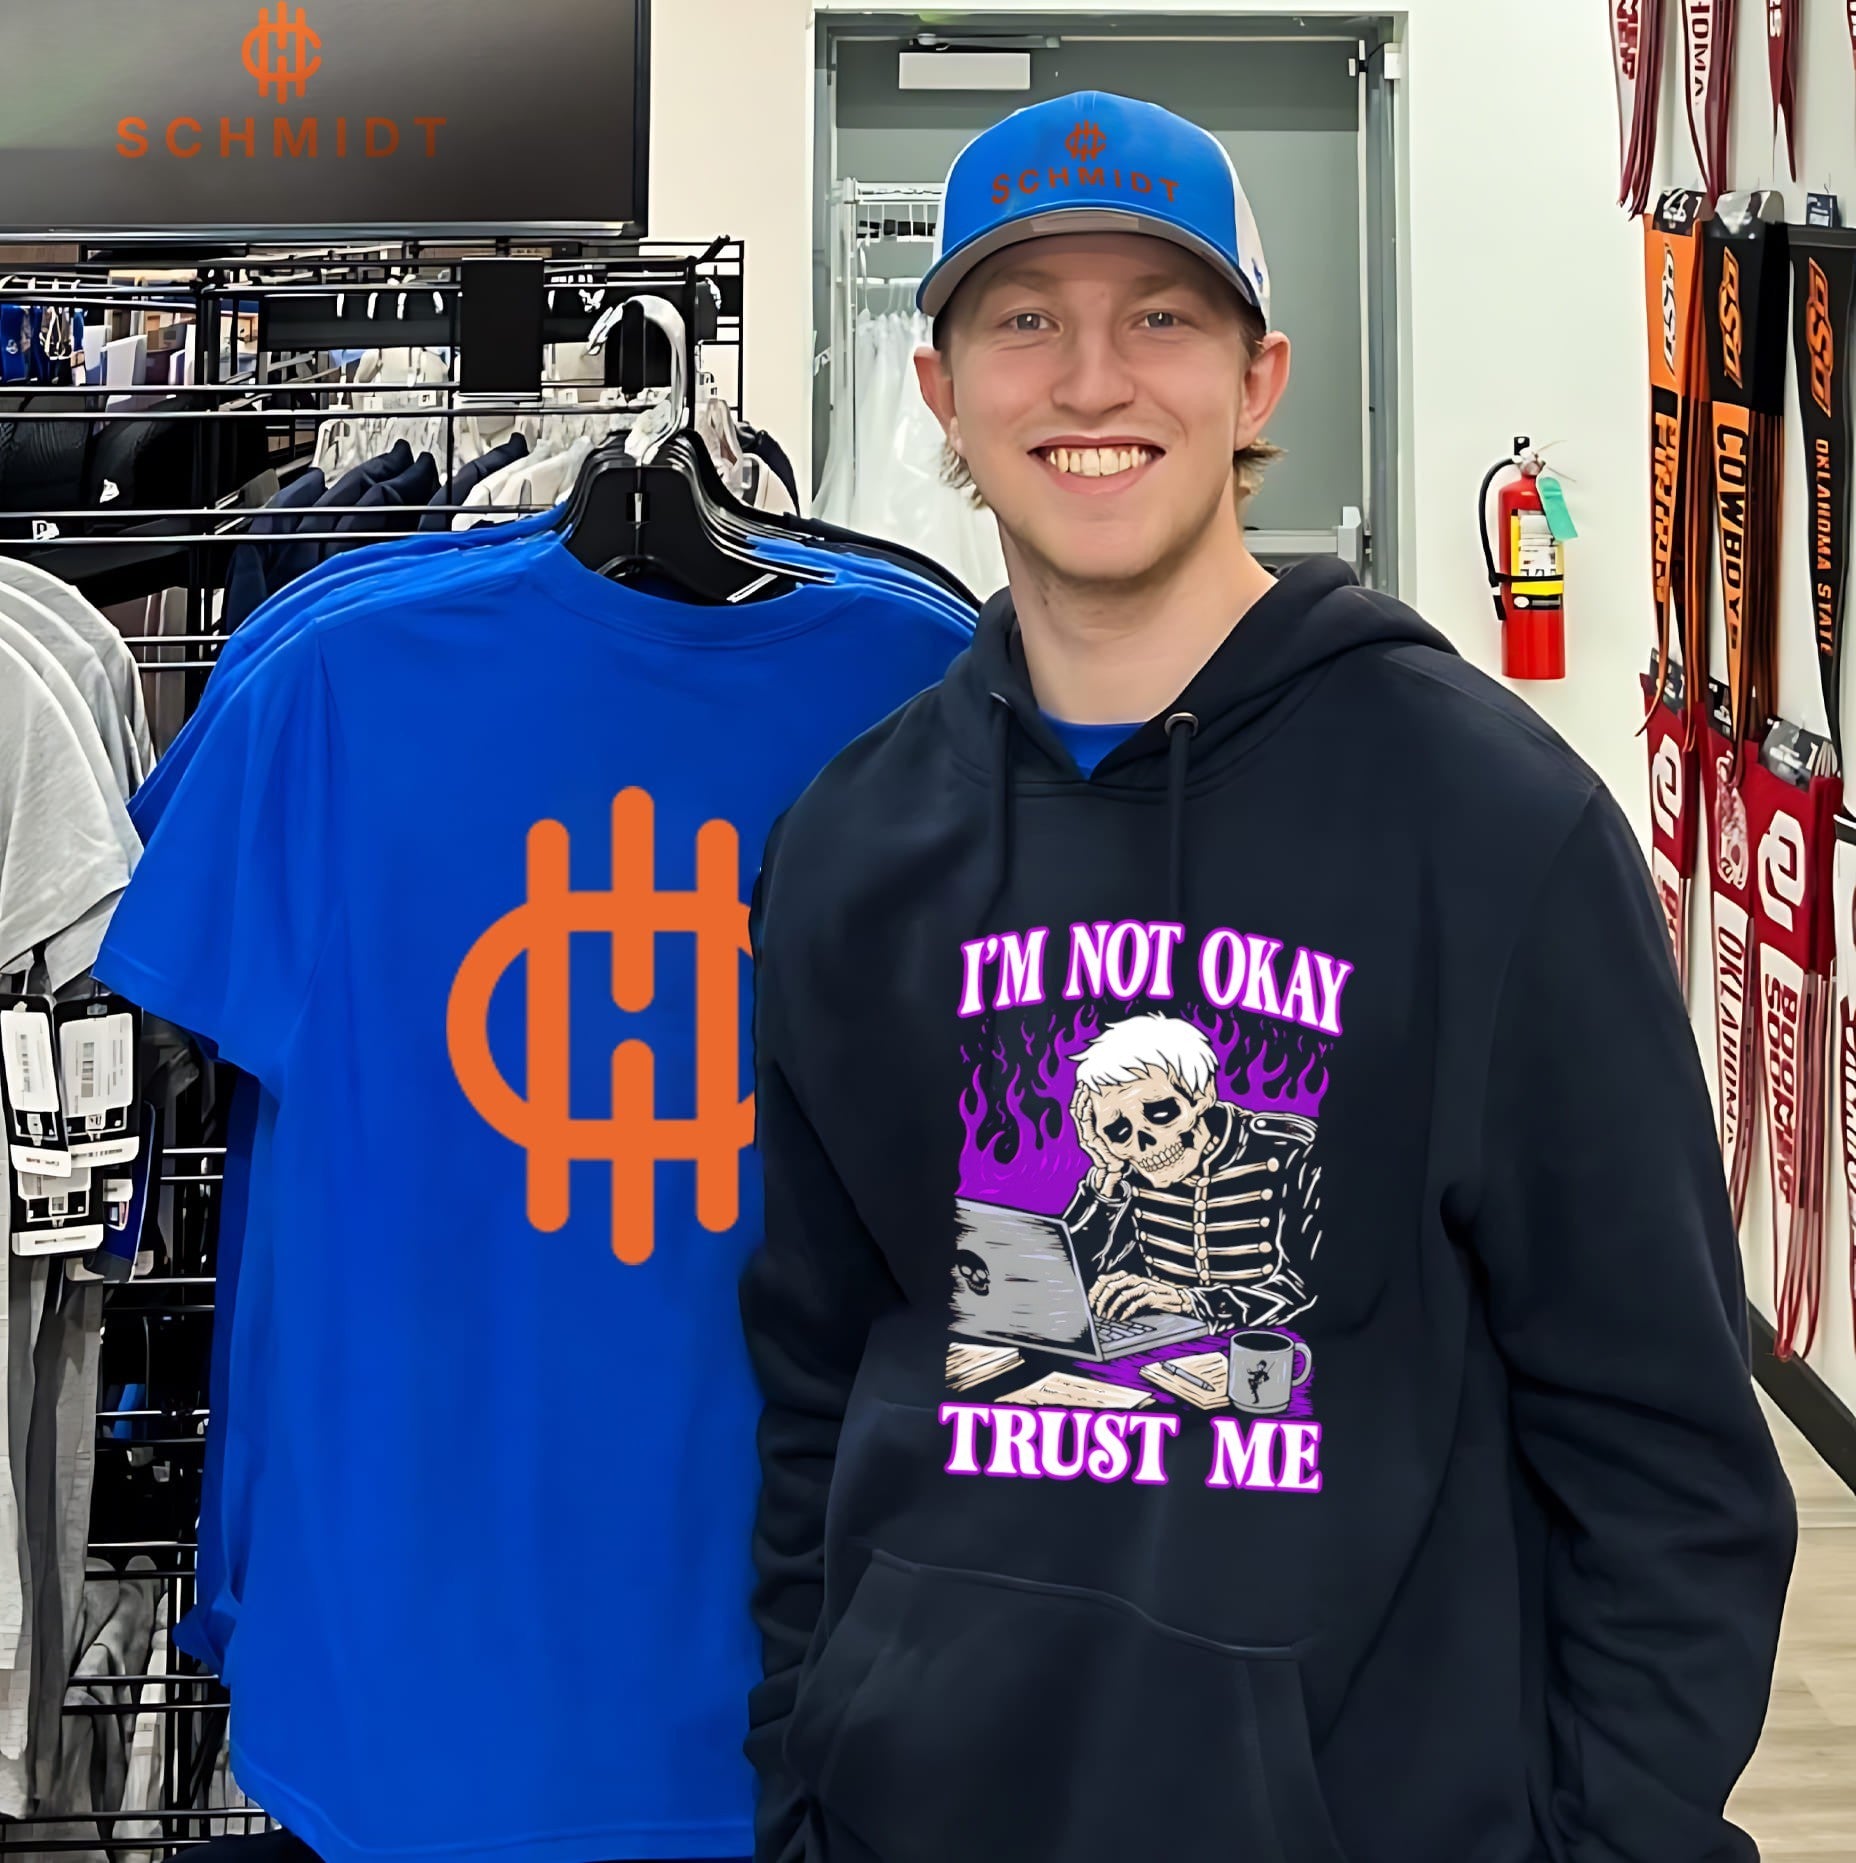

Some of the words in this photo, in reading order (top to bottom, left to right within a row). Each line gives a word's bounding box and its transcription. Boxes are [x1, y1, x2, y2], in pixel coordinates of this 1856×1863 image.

[115, 116, 447, 158] SCHMIDT
[991, 166, 1180, 205] SCHMIDT
[1814, 438, 1832, 571] OKLAHOMA
[957, 926, 1050, 1018] I'M
[1064, 919, 1185, 1002] NOT
[1199, 927, 1355, 1036] OKAY
[1718, 926, 1745, 1144] OKLAHOMA
[939, 1402, 1179, 1485] TRUST
[1204, 1415, 1323, 1493] ME
